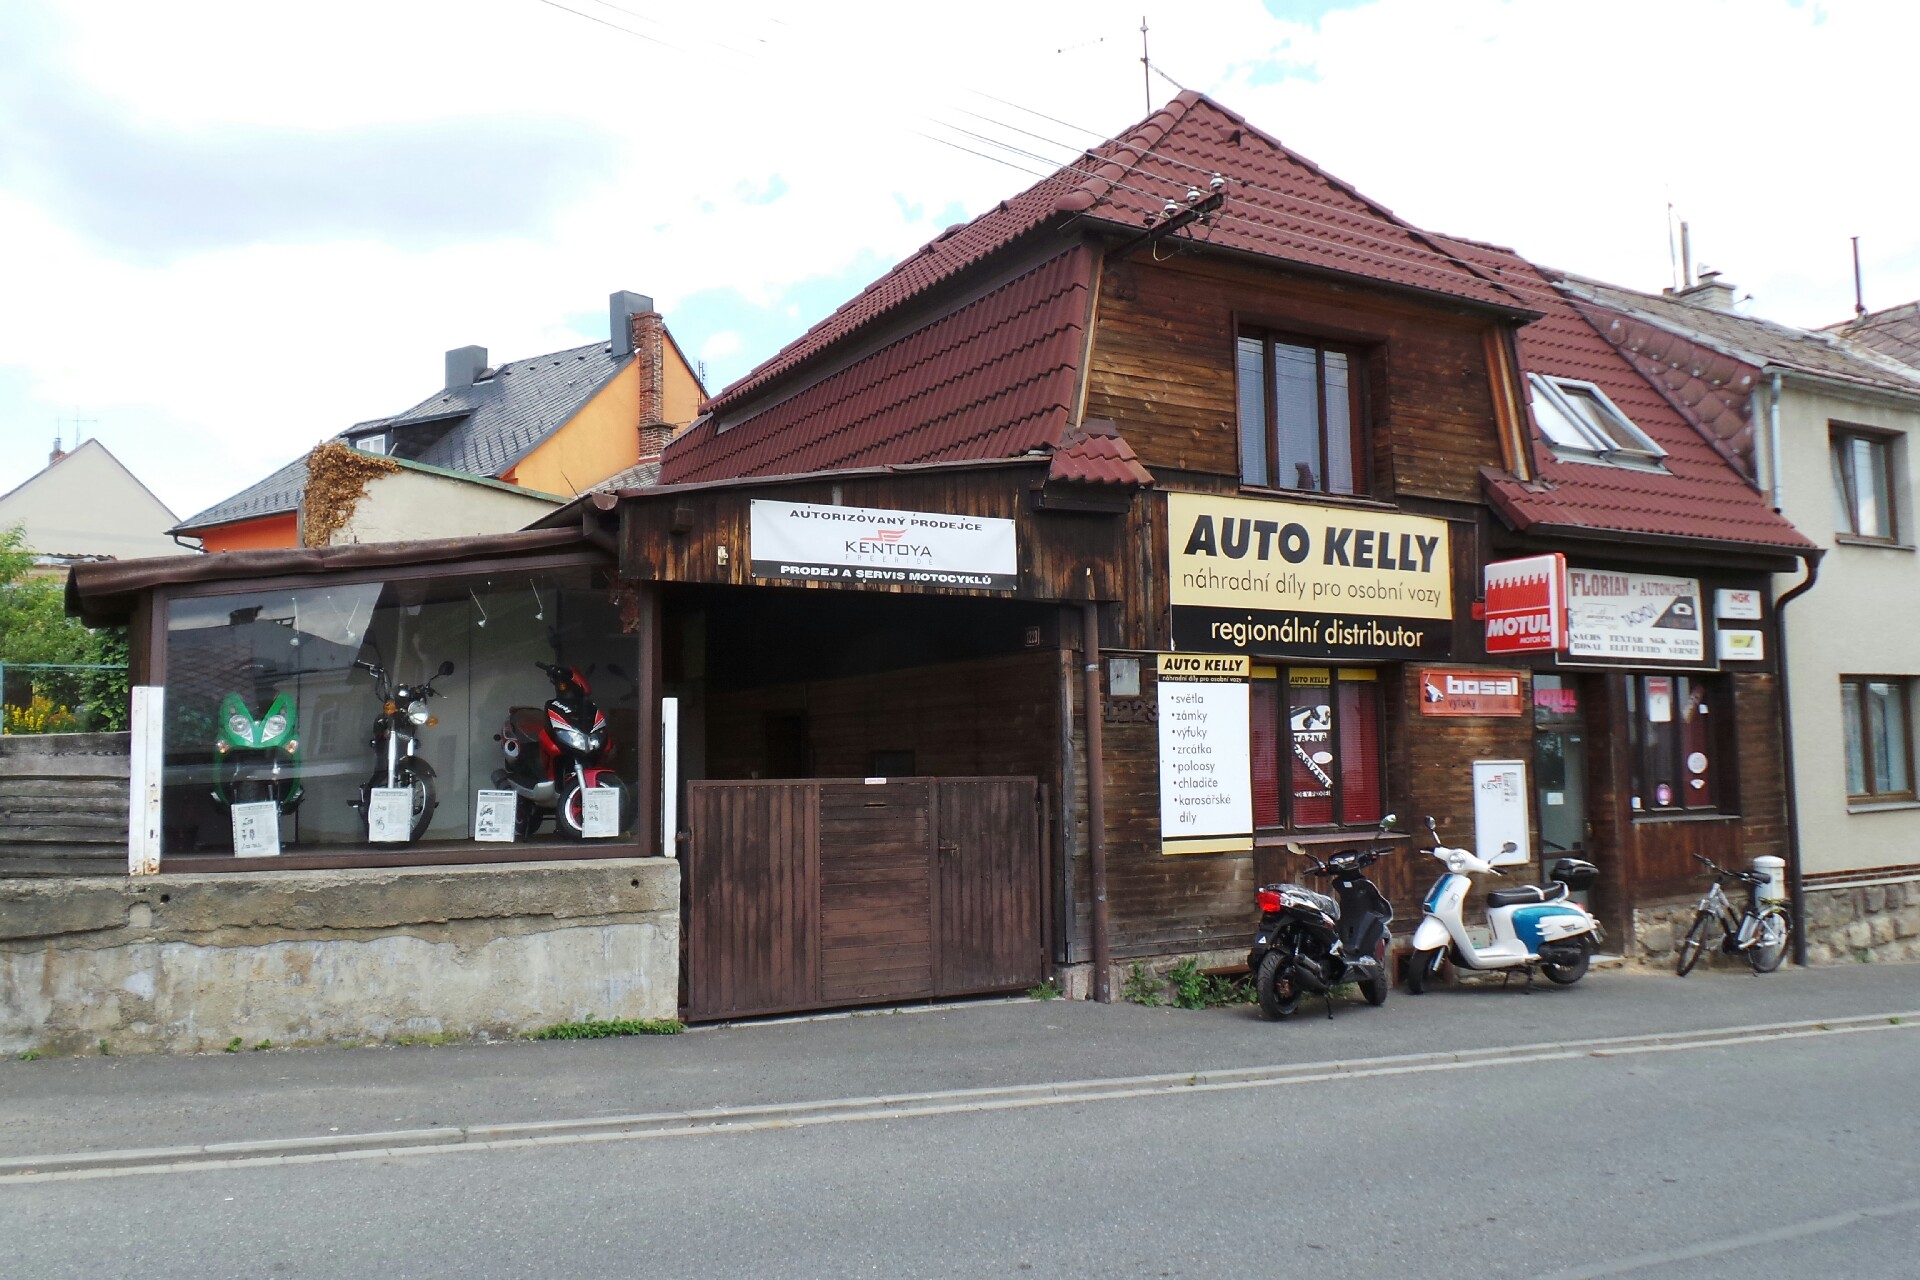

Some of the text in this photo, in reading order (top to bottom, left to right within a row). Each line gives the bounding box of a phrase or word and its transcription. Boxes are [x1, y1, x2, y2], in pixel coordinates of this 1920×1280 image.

[910, 519, 982, 531] PRODEJCE
[845, 541, 932, 557] KENTOYA
[1183, 514, 1439, 573] AUTO KELLY
[845, 554, 933, 566] FREERIDE
[781, 565, 992, 585] PRODEJ A SERVIS MOTOCYKLŮ
[1183, 567, 1441, 608] náhradní díly pro osobní vozy
[1570, 573, 1629, 596] FLORIAN
[1211, 616, 1424, 648] regionální distributor
[1487, 614, 1551, 638] MOTUL
[1163, 658, 1244, 672] AUTO KELLY
[1447, 675, 1518, 695] bosal
[1175, 693, 1204, 704] světla
[1176, 710, 1208, 724] zámky
[1177, 726, 1207, 740] výfuky
[1177, 743, 1212, 755] zrcátka
[1177, 760, 1216, 774] poloosy
[1178, 776, 1219, 789] chladiče
[1179, 793, 1231, 806] karosářské
[1179, 811, 1197, 826] díly
